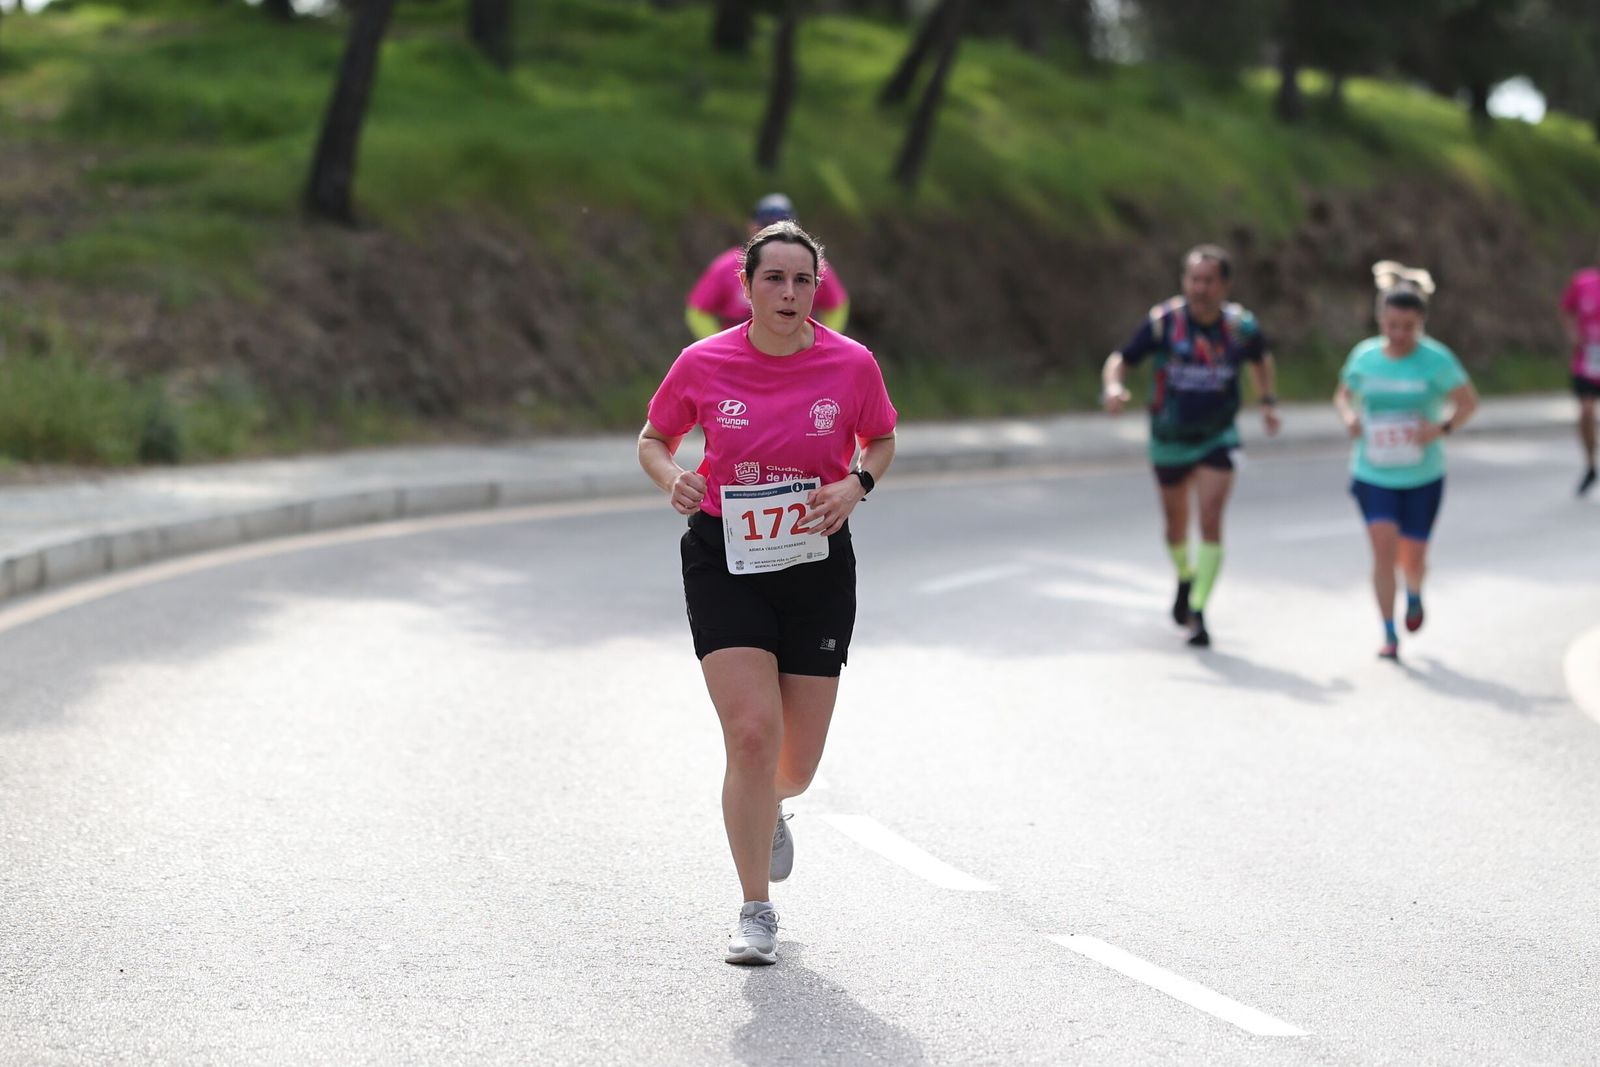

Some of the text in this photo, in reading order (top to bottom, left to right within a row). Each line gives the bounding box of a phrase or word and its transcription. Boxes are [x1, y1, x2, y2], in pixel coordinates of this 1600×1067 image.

[716, 417, 749, 426] HYUNDAI
[766, 472, 780, 482] de
[741, 503, 810, 540] 172
